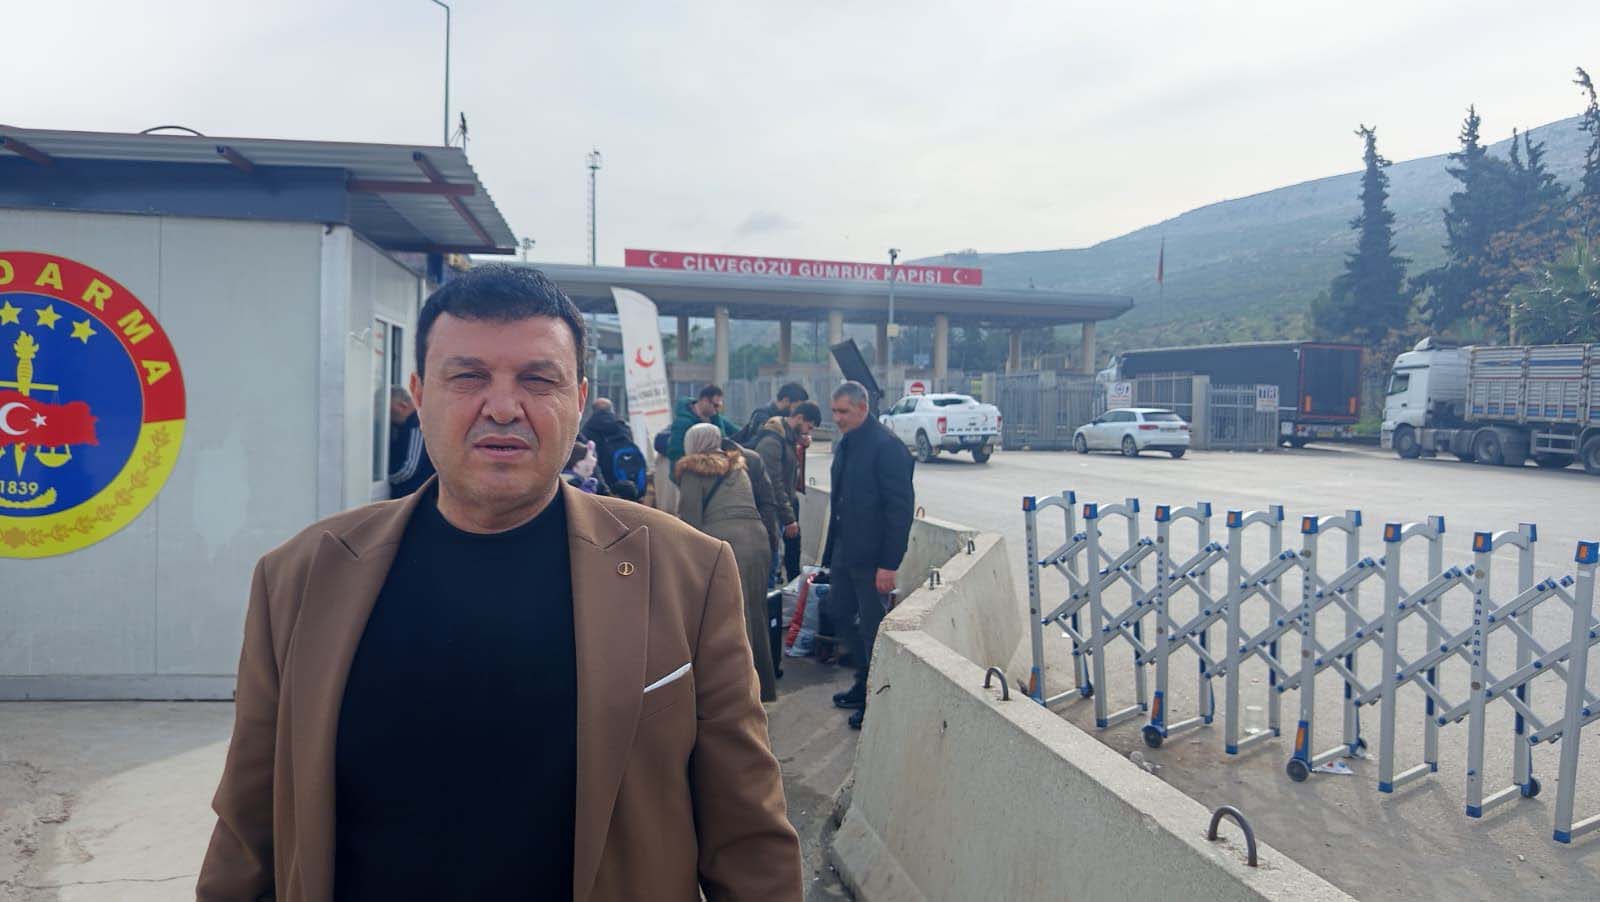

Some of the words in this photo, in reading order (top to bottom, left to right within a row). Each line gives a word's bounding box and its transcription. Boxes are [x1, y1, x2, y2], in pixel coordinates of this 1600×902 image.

[798, 262, 878, 282] GÜMRÜK
[0, 480, 39, 496] 1839
[1472, 588, 1483, 667] JANDARMA
